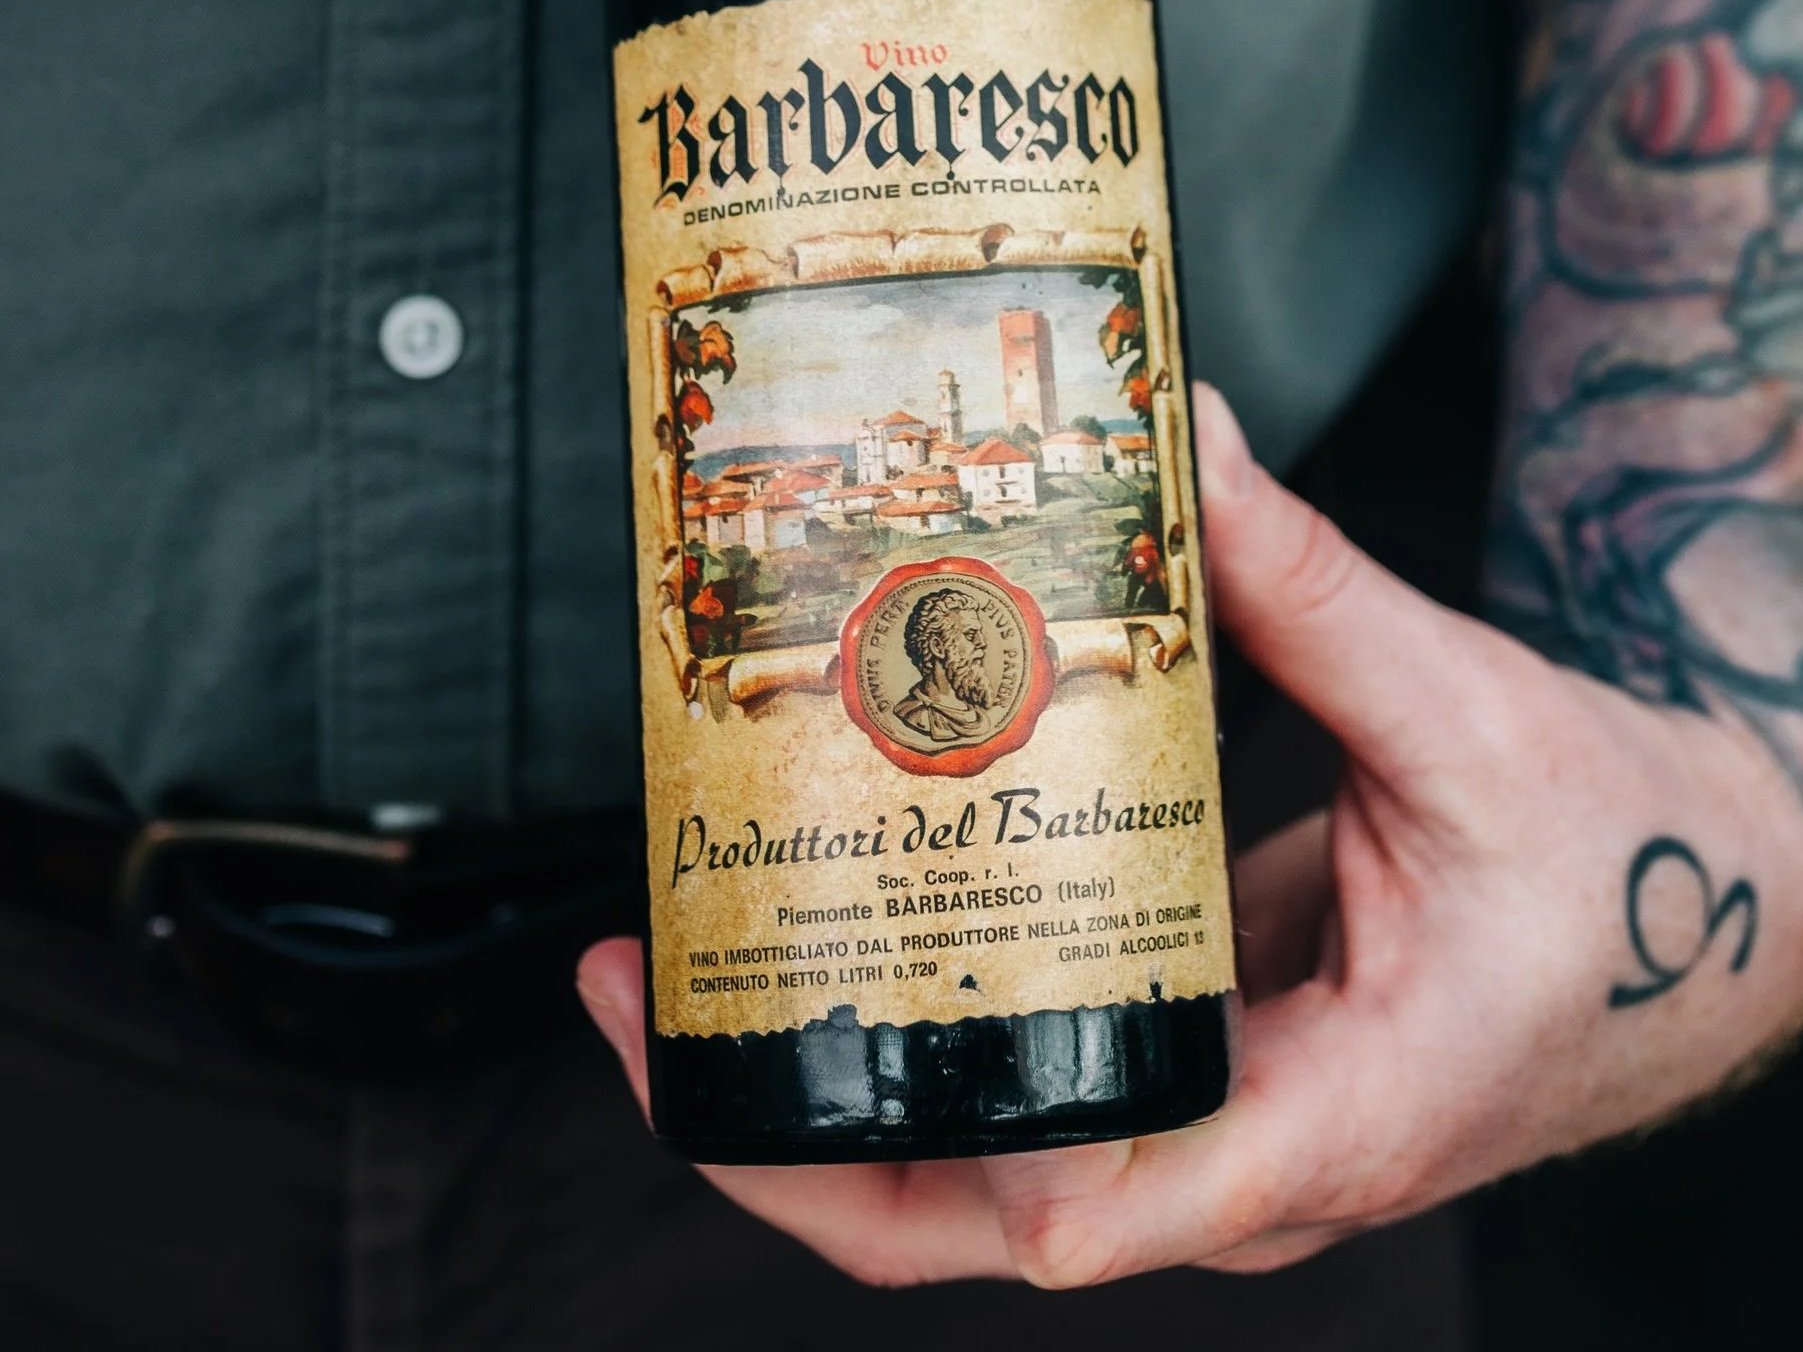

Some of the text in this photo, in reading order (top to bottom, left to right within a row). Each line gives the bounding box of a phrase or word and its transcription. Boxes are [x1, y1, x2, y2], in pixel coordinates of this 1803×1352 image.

[862, 40, 949, 70] Vino
[637, 57, 1140, 208] Barbaresco
[684, 178, 1102, 226] DENOMINAZIONE CONTROLLATA
[672, 787, 1205, 890] Produttori del Barbaresco
[778, 876, 1116, 927] Piemonte BARBARESCO (Italy)
[878, 874, 914, 890] Soc.
[924, 869, 975, 886] Coop.
[985, 868, 998, 880] r.
[689, 903, 1202, 968] VINO IMBOTTIGLIATO DAL PRODUTTORE NELLA ZONA DI ORIGINE
[1058, 942, 1110, 963] GRADI
[1119, 931, 1189, 956] ALCOOLICI
[691, 961, 938, 994] CONTENUTO NETTO LITRI 0,720
